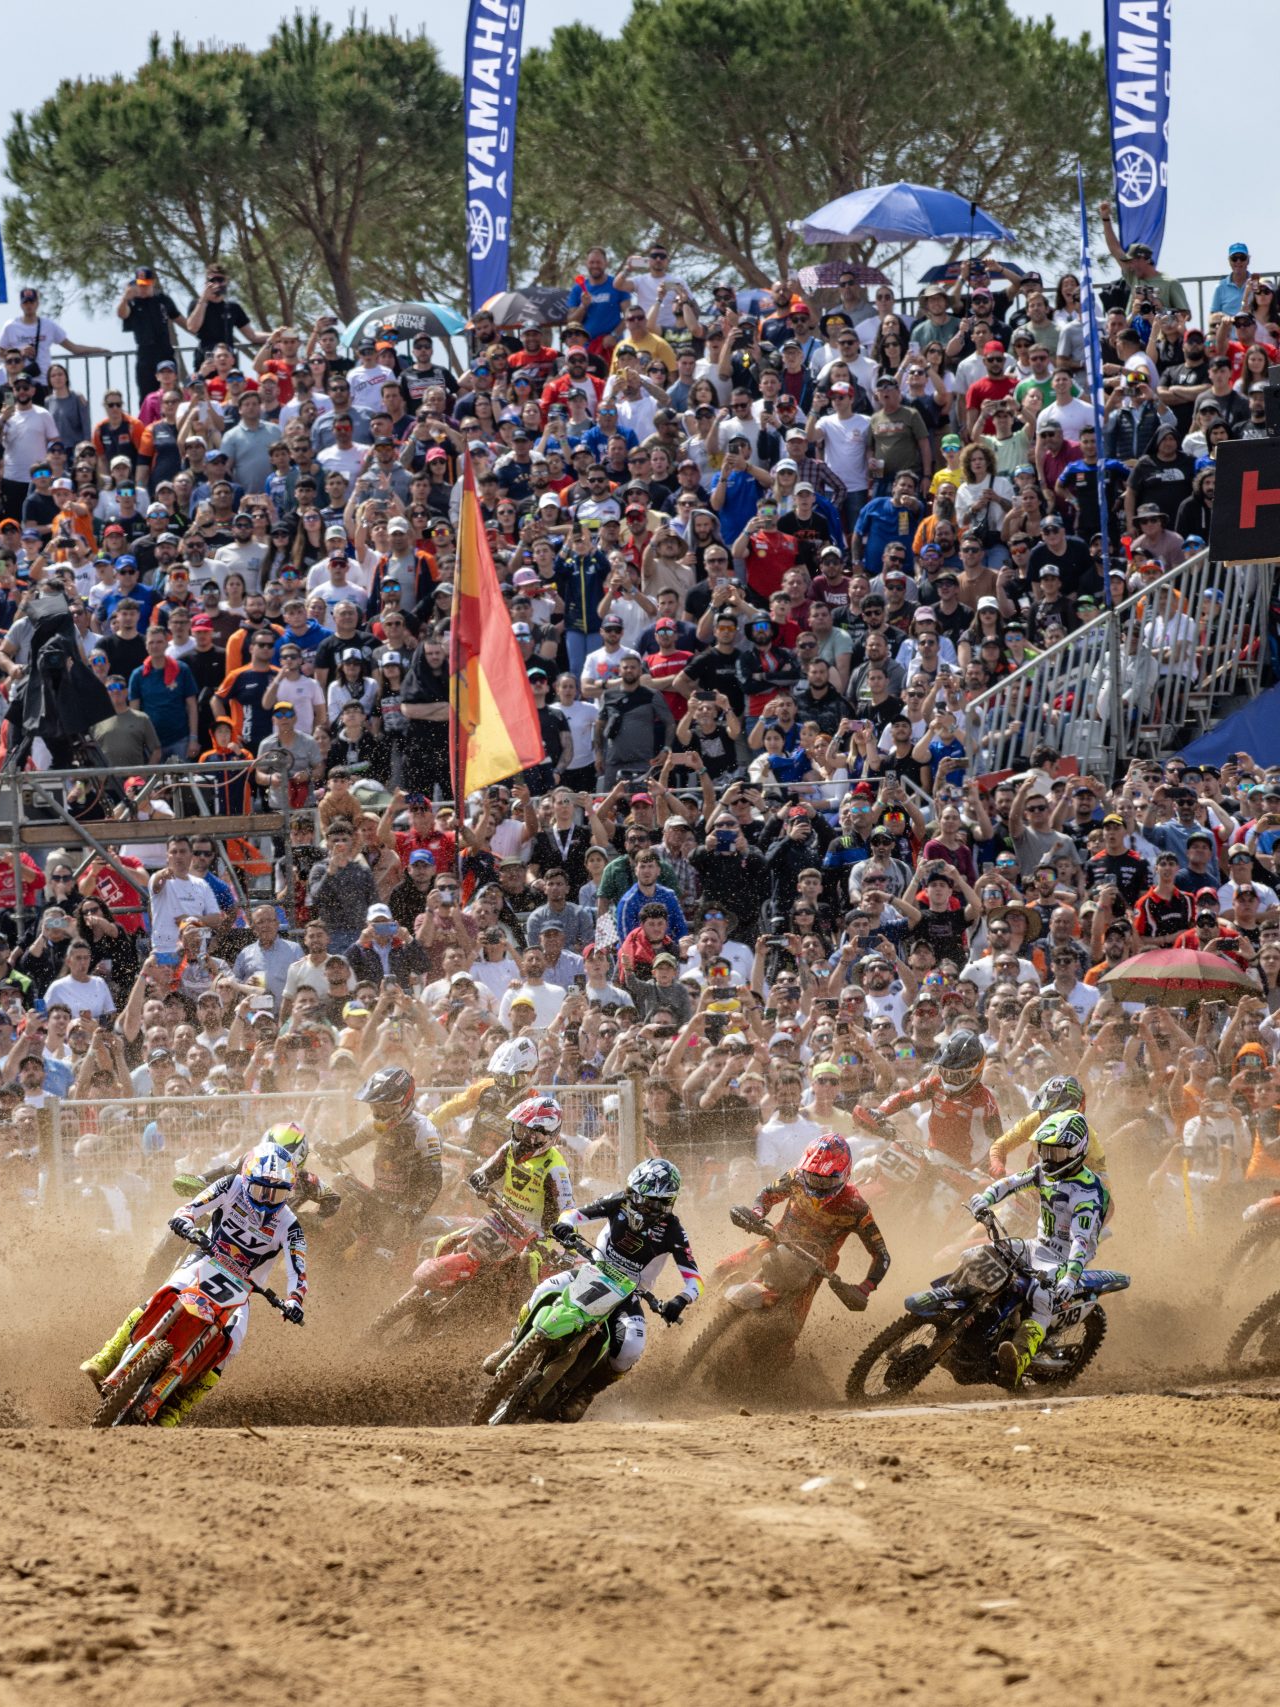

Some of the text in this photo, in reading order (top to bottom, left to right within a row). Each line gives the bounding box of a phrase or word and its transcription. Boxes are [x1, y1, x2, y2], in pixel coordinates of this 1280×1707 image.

[222, 1218, 269, 1249] FLY
[607, 1245, 644, 1271] Kawasaki
[199, 1272, 244, 1304] 5
[576, 1280, 611, 1306] 1
[1057, 1306, 1083, 1330] 243
